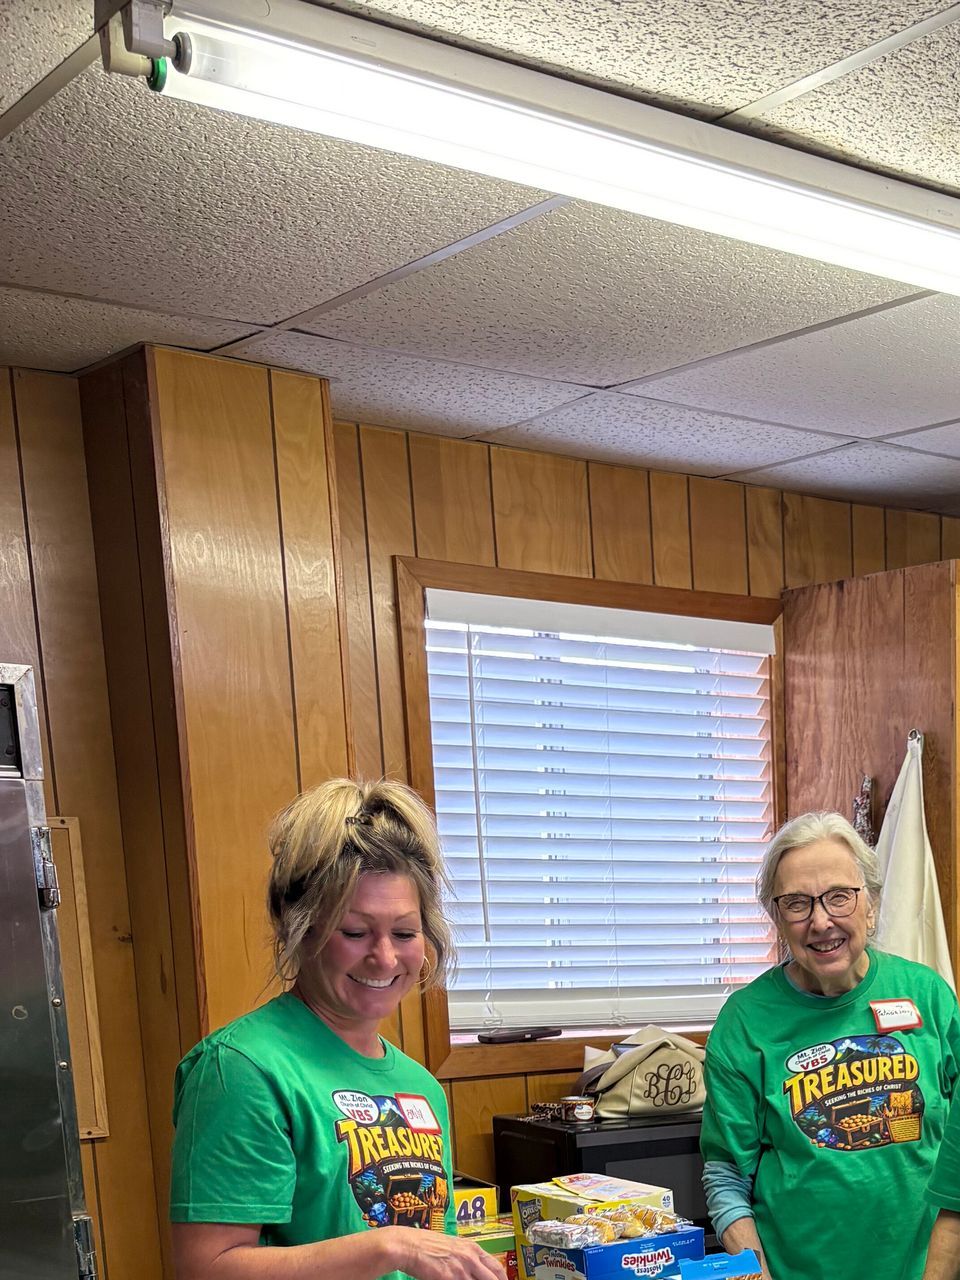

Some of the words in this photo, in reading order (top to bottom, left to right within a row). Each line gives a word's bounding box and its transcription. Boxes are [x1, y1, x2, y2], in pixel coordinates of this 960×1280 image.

[797, 1052, 810, 1060] Mt.
[811, 1046, 826, 1054] Zion
[800, 1054, 828, 1070] VBS
[785, 1053, 919, 1115] TREASURED
[350, 1094, 368, 1102] Zion
[824, 1094, 846, 1106] SEEKING
[847, 1090, 856, 1098] THE
[857, 1086, 874, 1095] RICHES
[346, 1108, 374, 1122] VBS
[457, 1196, 486, 1220] 48
[544, 1256, 576, 1272] Twinkies
[624, 1249, 672, 1267] Twinkies
[636, 1264, 662, 1274] Hostess
